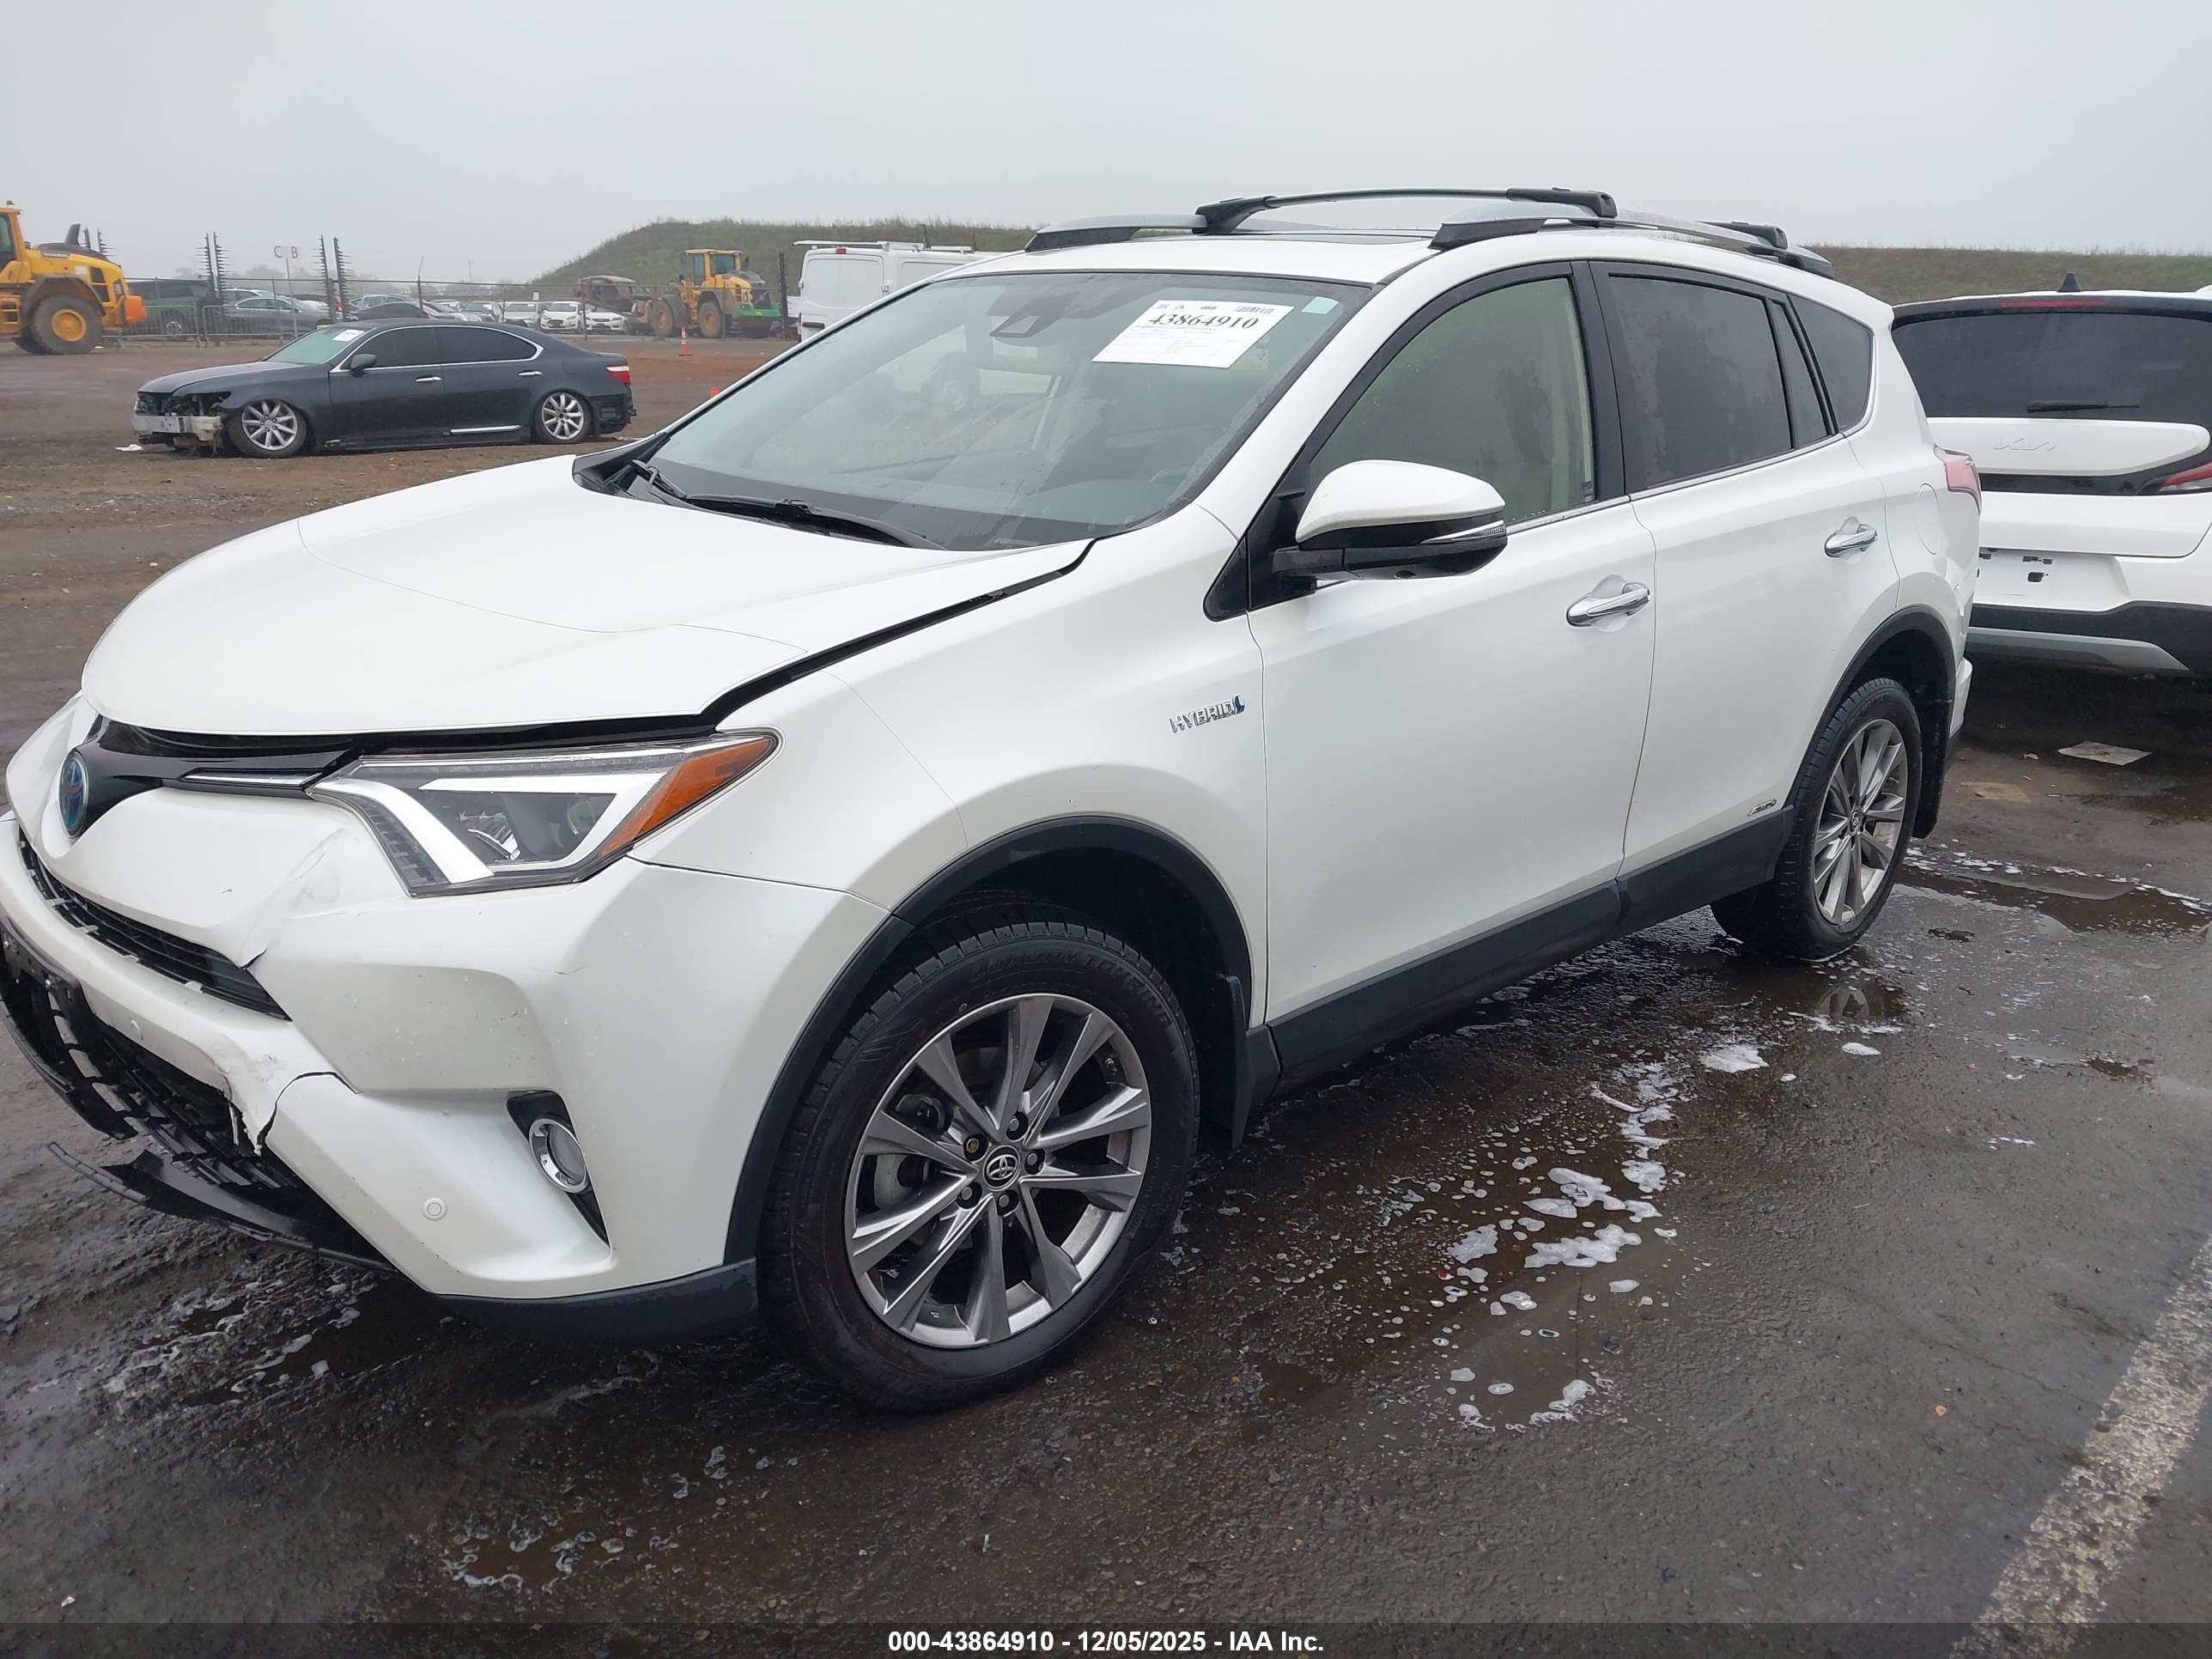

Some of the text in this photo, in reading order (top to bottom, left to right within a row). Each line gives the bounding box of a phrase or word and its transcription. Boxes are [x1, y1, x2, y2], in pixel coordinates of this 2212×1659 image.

[290, 246, 299, 259] B
[1149, 313, 1260, 329] 43864910
[1169, 701, 1237, 733] HYBRID
